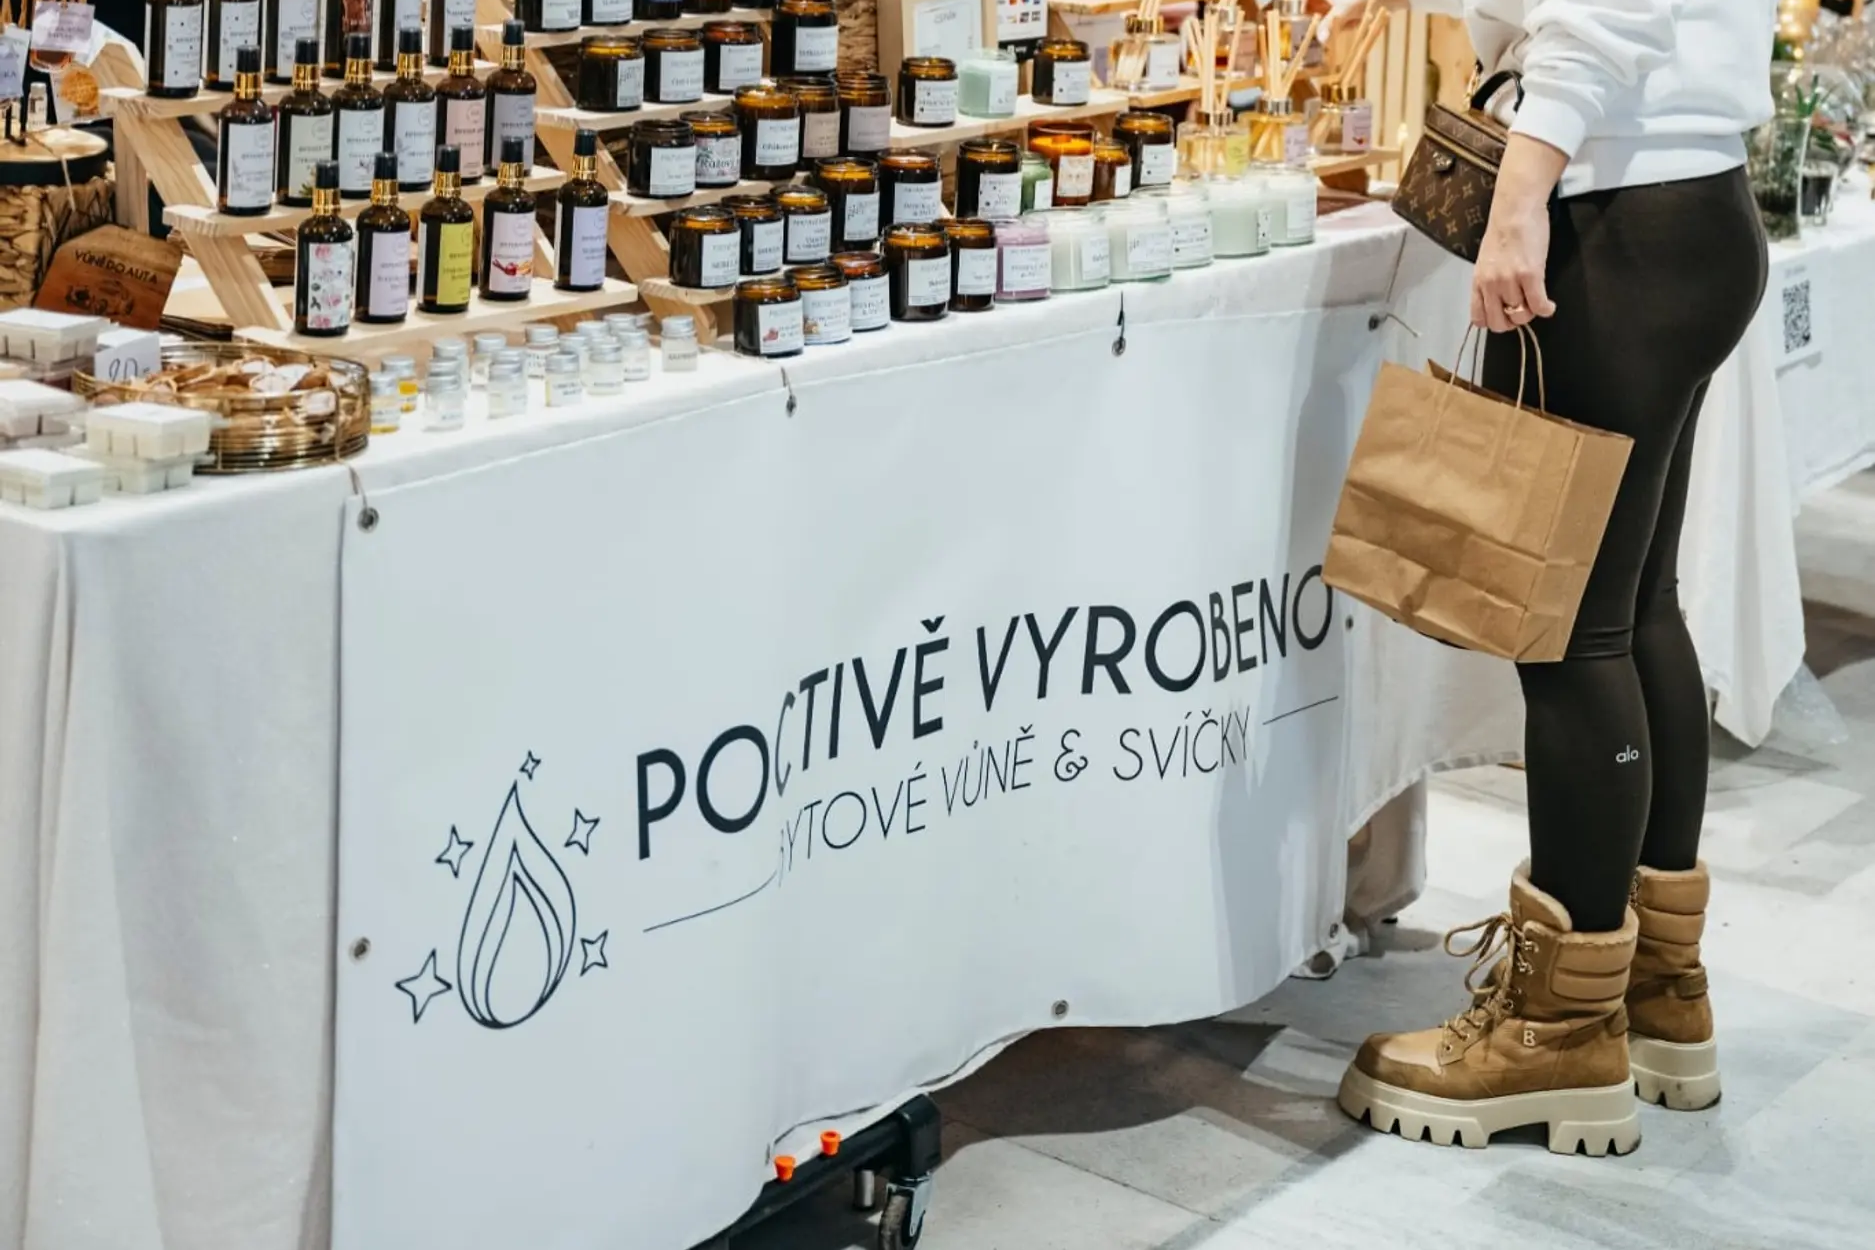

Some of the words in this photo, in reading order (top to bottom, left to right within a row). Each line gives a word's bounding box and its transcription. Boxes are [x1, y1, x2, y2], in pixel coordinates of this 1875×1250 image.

[106, 258, 126, 274] DO
[125, 266, 158, 285] AUTA
[636, 614, 950, 861] POCTIVĚ
[976, 563, 1334, 714] VYROBENO
[941, 723, 1036, 817] VŮNĚ
[1053, 728, 1089, 782] &
[1112, 705, 1251, 782] SVÍČKY
[1615, 744, 1639, 763] alo
[1523, 1029, 1536, 1047] B
